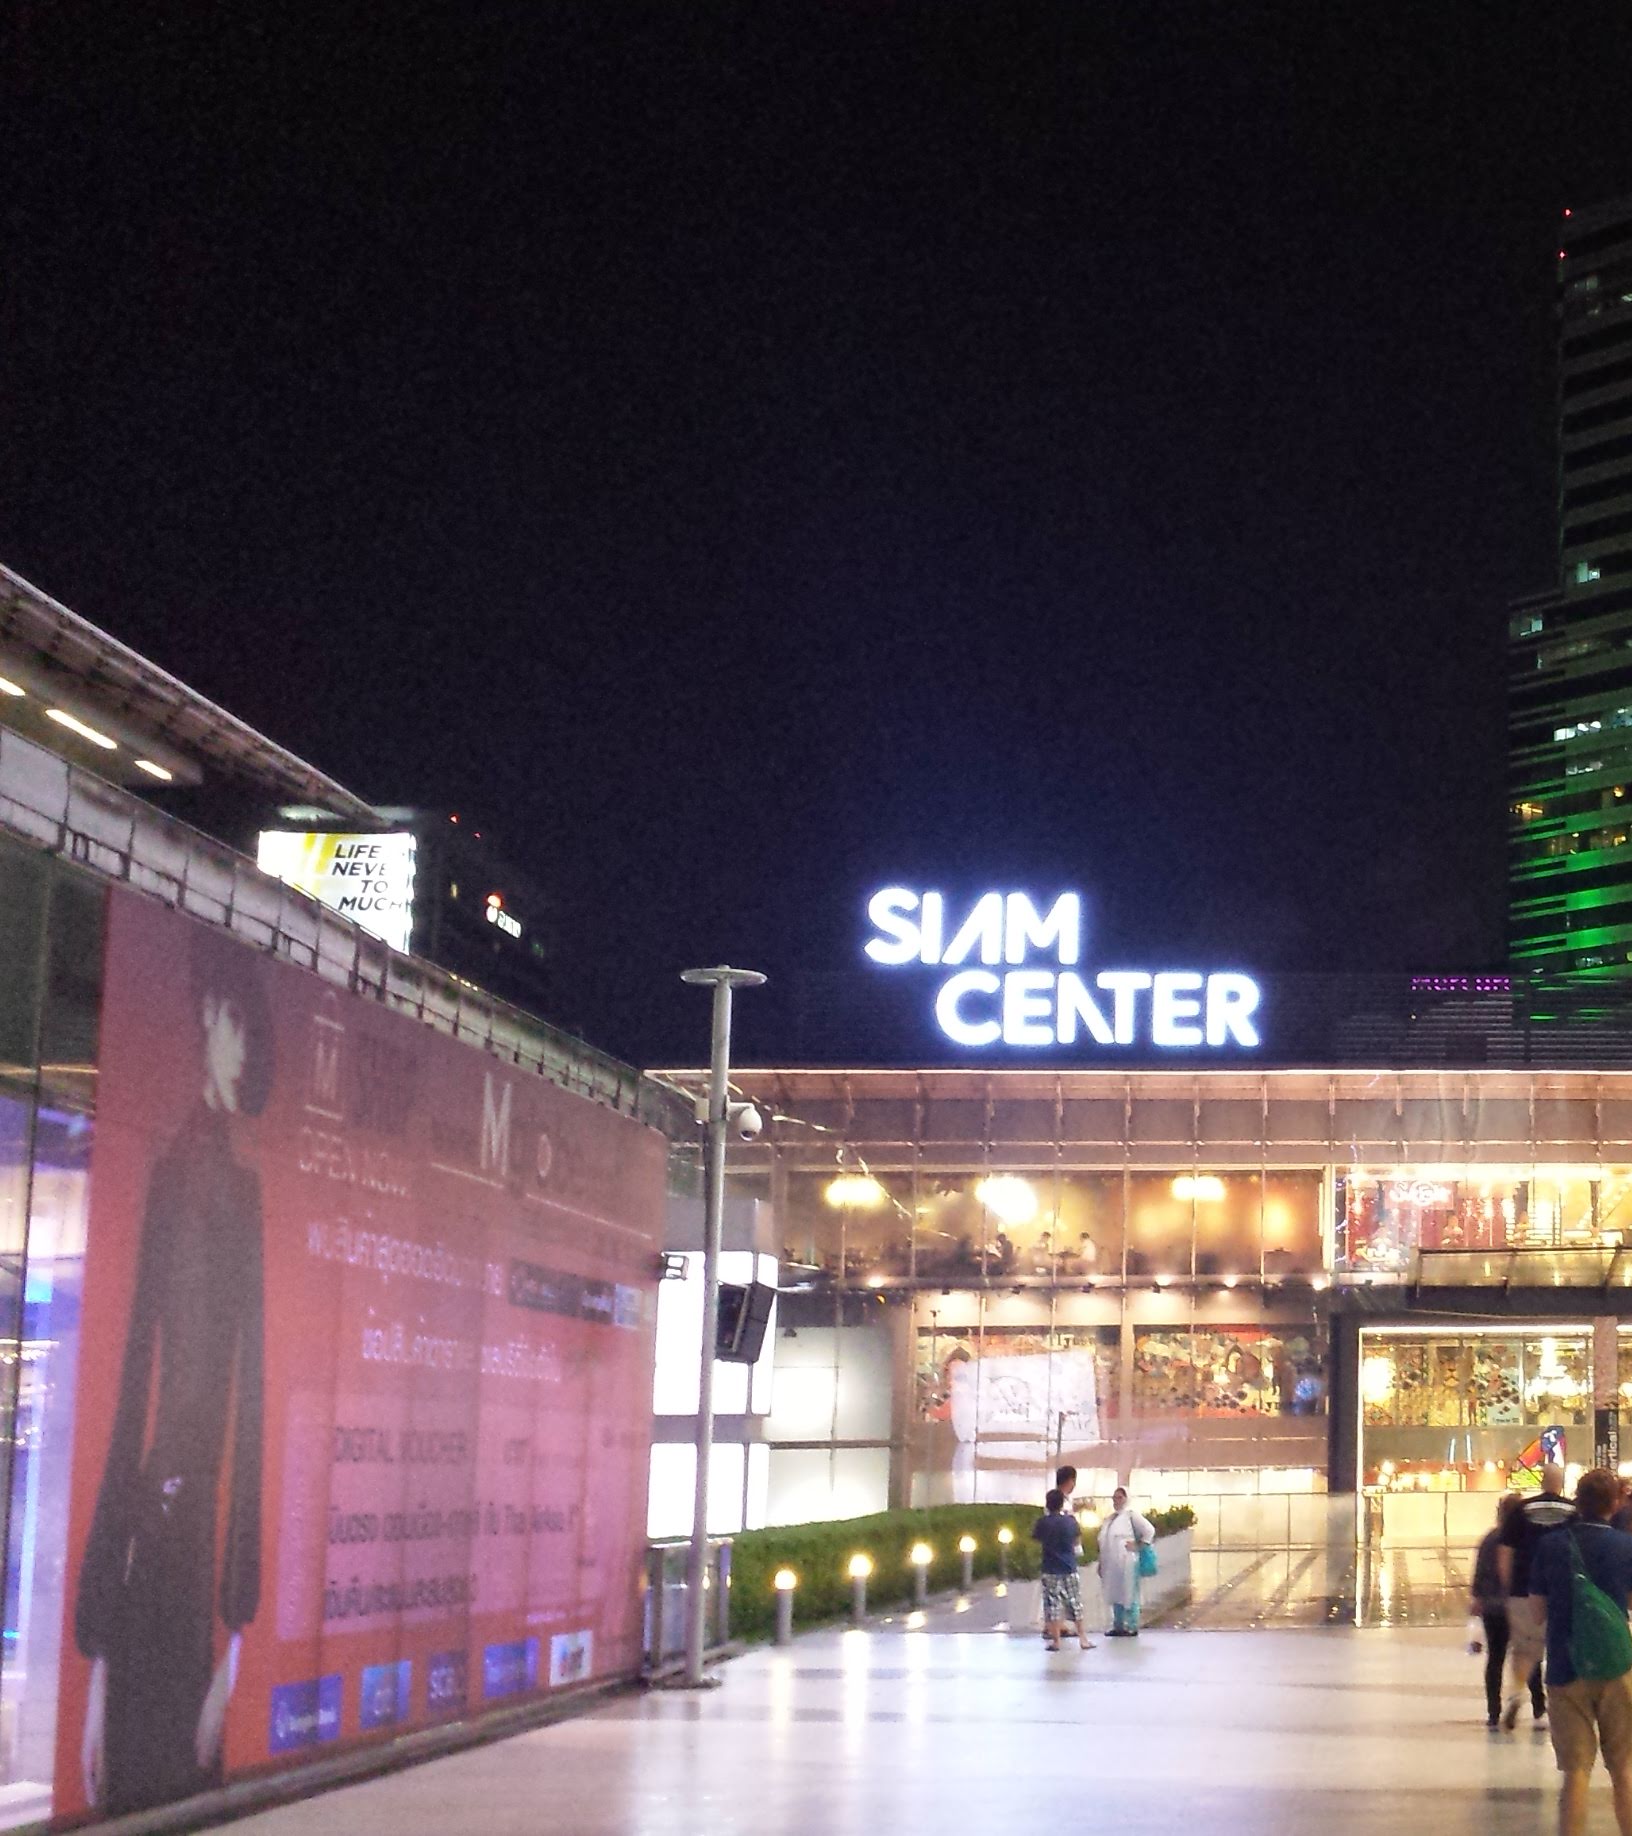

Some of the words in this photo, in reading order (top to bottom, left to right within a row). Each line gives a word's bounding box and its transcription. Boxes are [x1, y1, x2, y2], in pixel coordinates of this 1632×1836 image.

[334, 843, 382, 859] LIFE
[361, 879, 389, 893] TO
[864, 887, 1080, 965] SIAM
[935, 970, 1261, 1047] CENTER
[1607, 1431, 1618, 1480] ertical
